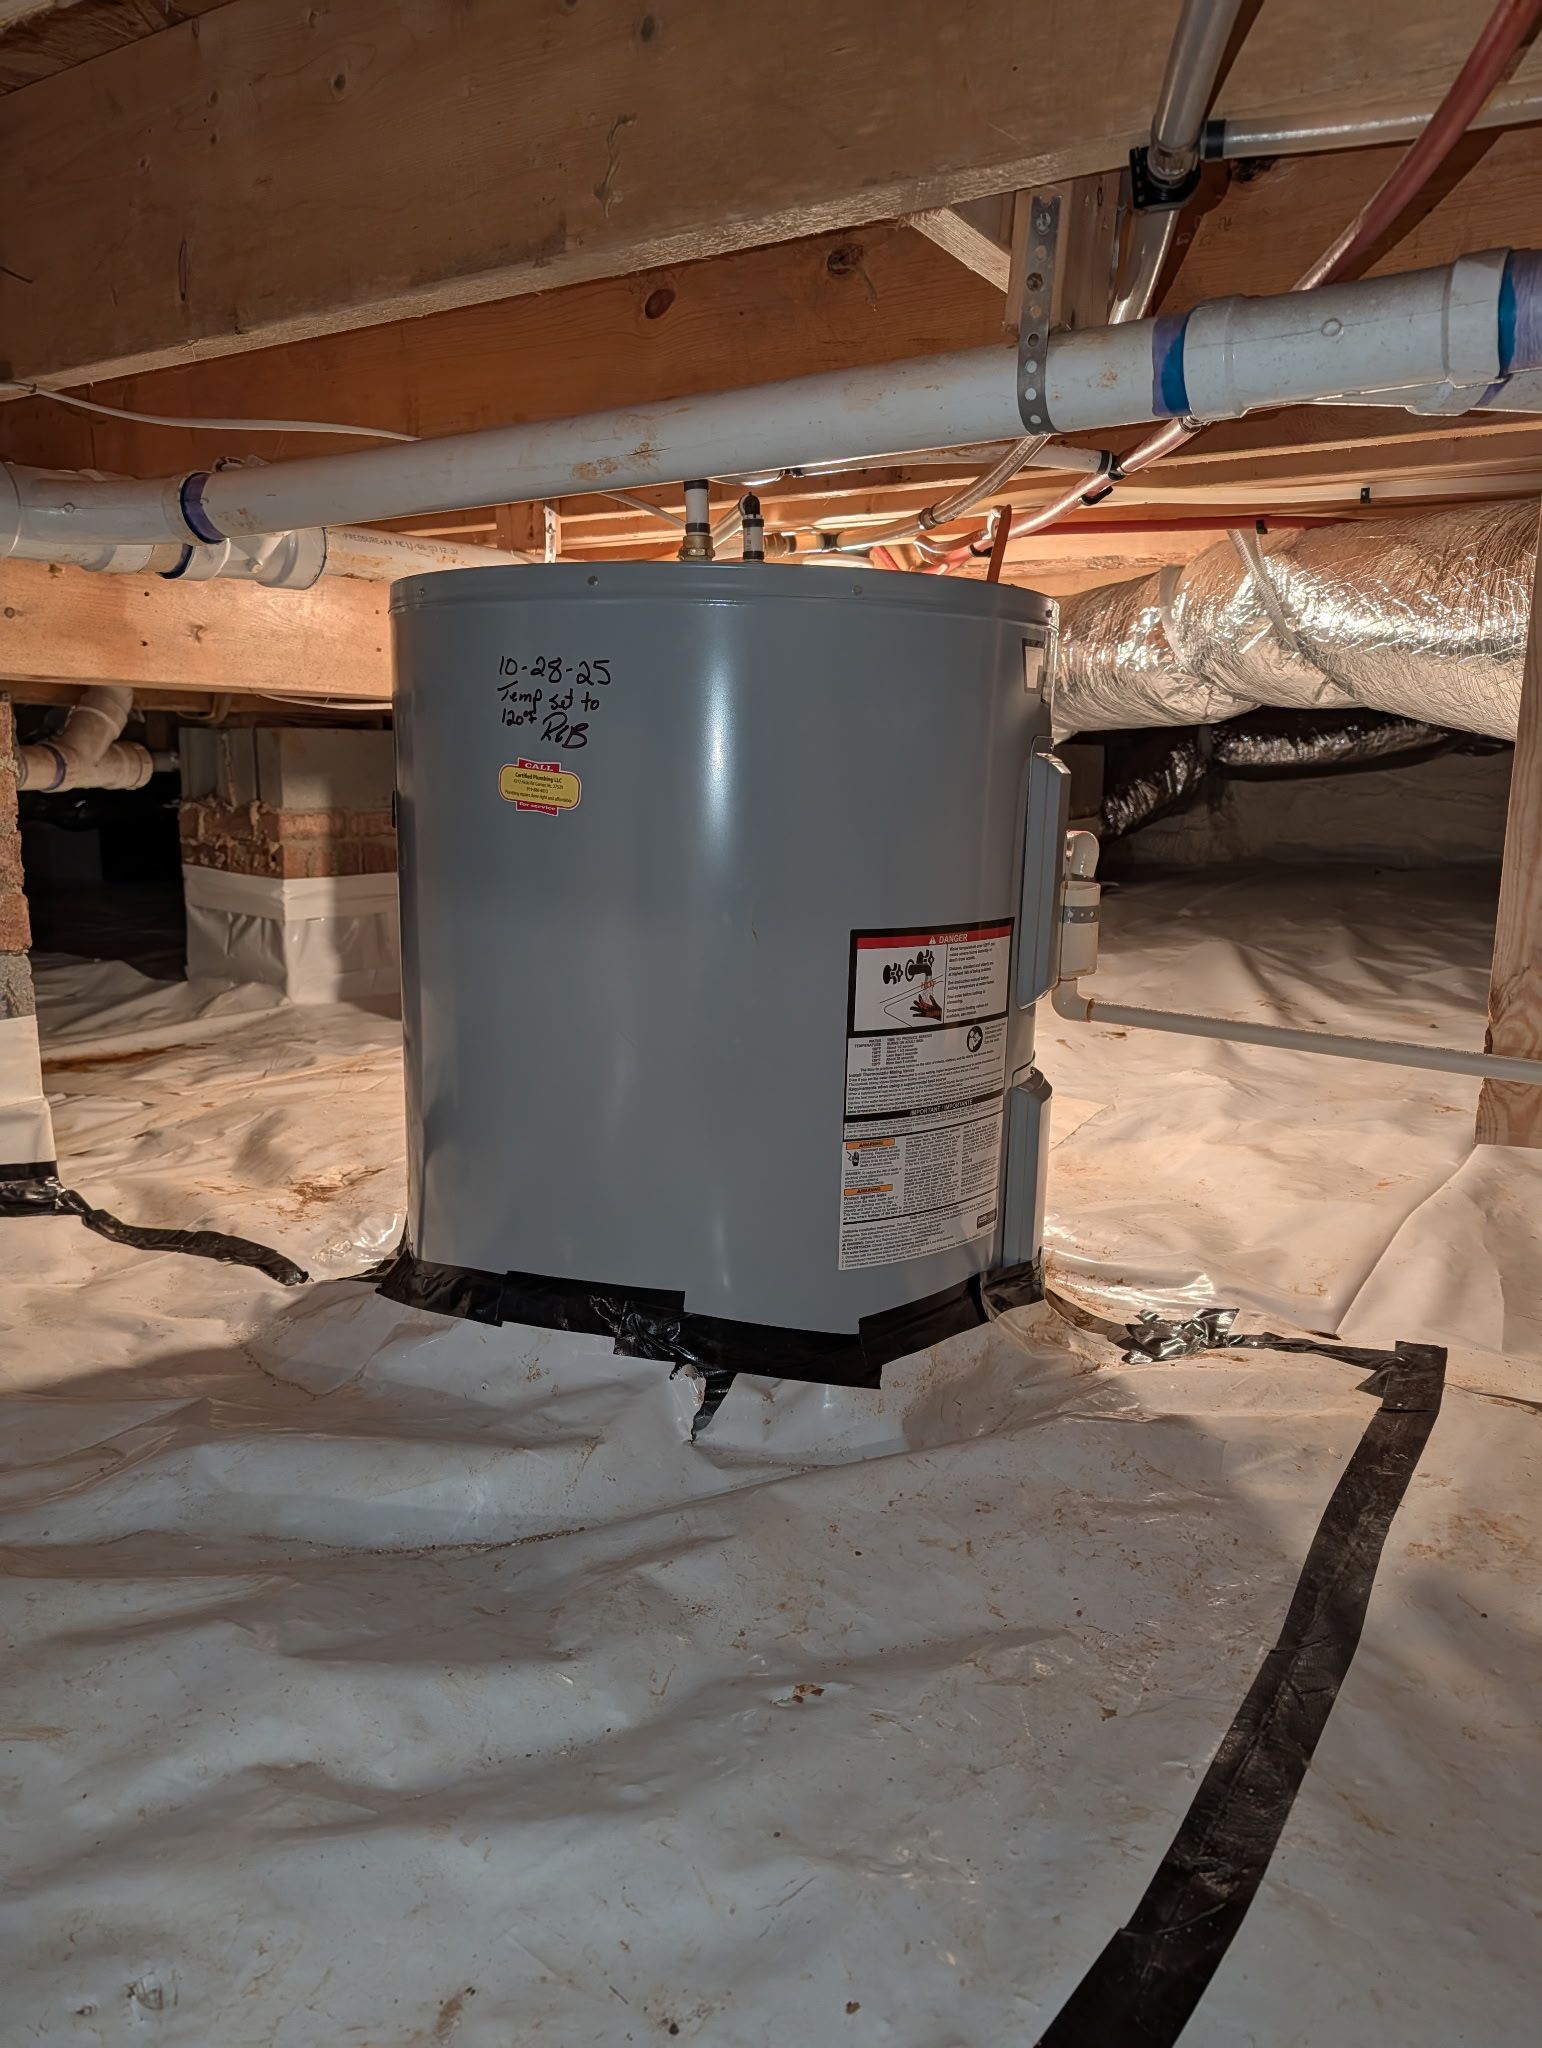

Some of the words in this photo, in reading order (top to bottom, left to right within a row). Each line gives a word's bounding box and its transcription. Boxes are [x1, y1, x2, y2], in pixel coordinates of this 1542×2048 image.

[499, 655, 611, 685] 10-28-25
[497, 680, 543, 713] Temp
[549, 688, 573, 710] set
[581, 692, 600, 712] to
[525, 763, 553, 771] CALL
[533, 775, 553, 783] Plumbing
[939, 934, 968, 944] DANGER
[910, 1105, 941, 1116] IMPORTANT
